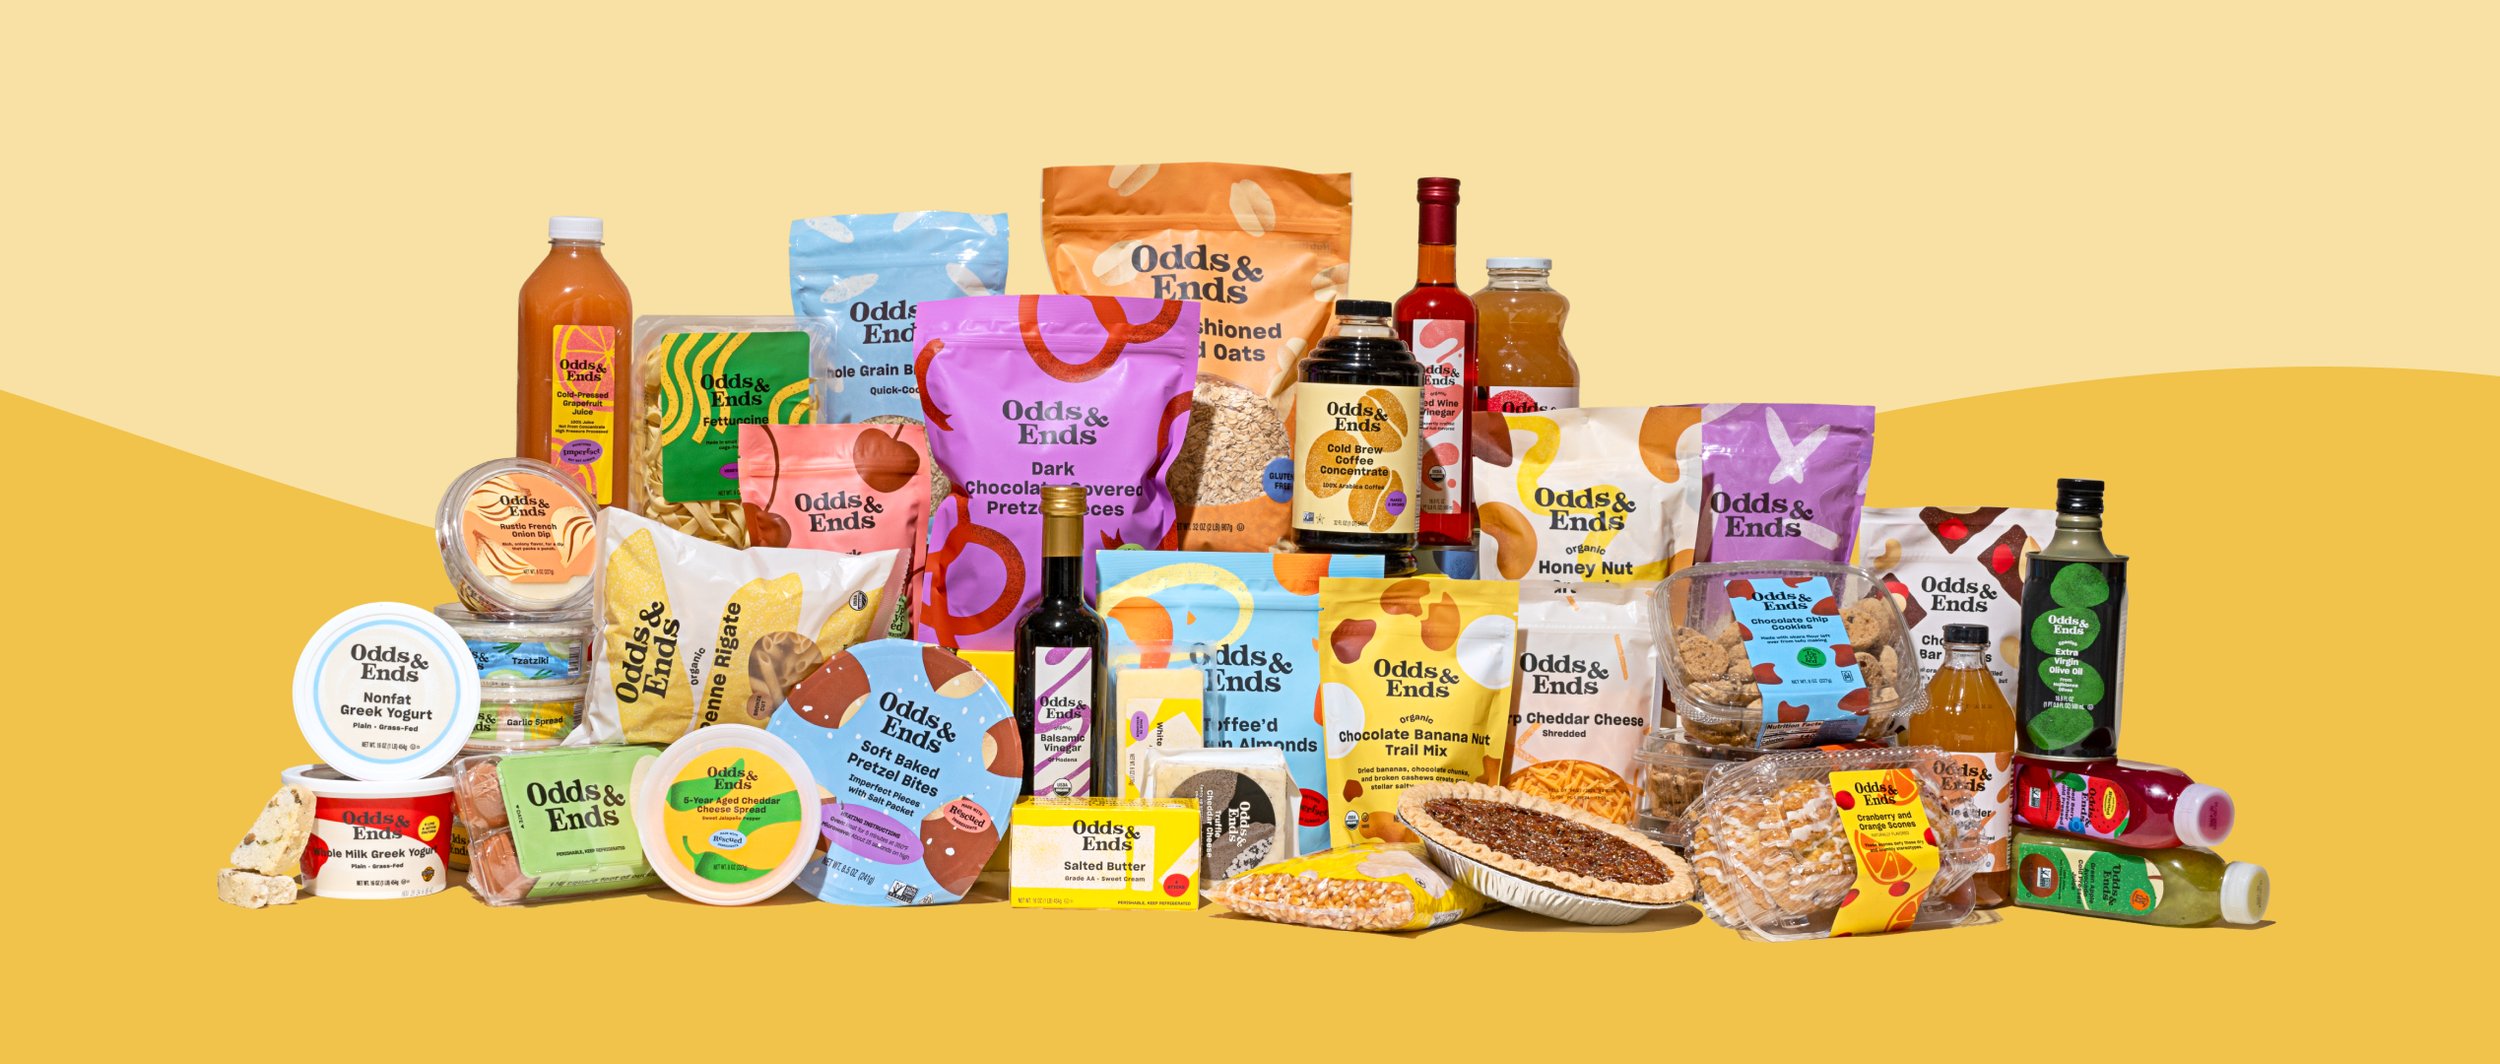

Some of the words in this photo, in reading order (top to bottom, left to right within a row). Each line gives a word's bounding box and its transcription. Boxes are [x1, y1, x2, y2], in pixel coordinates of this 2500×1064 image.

[1151, 273, 1248, 304] Ends
[850, 300, 917, 322] Odds
[863, 322, 917, 344] End
[1214, 344, 1265, 362] Oats
[567, 370, 602, 382] Ends
[860, 364, 899, 376] Grain
[1424, 375, 1456, 386] Ends
[563, 400, 602, 408] Grapefruit
[711, 391, 762, 408] Ends
[1437, 399, 1459, 408] Wine
[572, 408, 594, 416] Juice
[703, 416, 769, 427] Fettuccine
[1334, 416, 1381, 432] Ends
[1018, 422, 1098, 446] Ends
[563, 448, 600, 456] Imperfect
[1328, 444, 1351, 453] Cold
[1355, 445, 1384, 454] Brew
[1336, 456, 1374, 464] Coffee
[1032, 462, 1075, 476] Dark
[1320, 466, 1388, 476] Concentrate
[510, 506, 546, 517] Ends
[808, 512, 876, 532] Ends
[1549, 509, 1625, 532] Ends
[1724, 516, 1802, 538] Ends
[512, 530, 536, 538] Onion
[538, 531, 551, 540] Dip
[1566, 544, 1606, 556] Organic
[1538, 560, 1596, 578] Honey
[1602, 561, 1633, 575] Nut
[1762, 601, 1808, 611] Ends
[1930, 594, 1988, 612] Ends
[1806, 616, 1828, 624] Chip
[716, 602, 742, 668] Rigate
[2053, 624, 2084, 635] Ends
[642, 618, 680, 699] Ends
[1920, 649, 1942, 660] Bar
[2056, 648, 2078, 656] Extra
[512, 656, 549, 664] Tzatziki
[2054, 657, 2078, 666] Virgin
[360, 662, 420, 682] Ends
[2049, 666, 2070, 674] Olive
[1204, 668, 1282, 692] Ends
[1532, 674, 1599, 695] Ends
[1386, 679, 1450, 698] Ends
[363, 692, 412, 705] Nonfat
[340, 704, 382, 718] Greek
[386, 708, 432, 722] Yogurt
[1046, 708, 1082, 719] Ends
[1400, 714, 1434, 724] Organic
[1526, 712, 1590, 725] Cheddar
[1594, 714, 1644, 726] Cheese
[352, 722, 372, 730] Plain
[378, 724, 418, 732] Grass-Fed
[506, 718, 532, 726] Garlic
[535, 716, 564, 726] Spread
[880, 714, 942, 754] Ends
[1040, 733, 1085, 742] Balsamic
[1156, 722, 1164, 746] White
[1339, 728, 1410, 743] Chocolate
[1414, 728, 1468, 743] Banana
[1472, 732, 1490, 746] Nut
[1542, 730, 1586, 738] Shredded
[1044, 743, 1082, 754] Vinegar
[1240, 738, 1318, 752] Almonds
[1386, 744, 1418, 756] Trail
[1424, 745, 1448, 757] Mix
[861, 740, 892, 760] Soft
[894, 752, 940, 780] Baked
[847, 752, 900, 783] Pretzel
[903, 774, 938, 798] Bites
[1358, 766, 1374, 774] Dried
[1376, 766, 1410, 774] bananas,
[1412, 766, 1446, 774] chocolate
[714, 778, 752, 790] Ends
[1362, 774, 1372, 782] and
[1374, 774, 1399, 782] broken
[1401, 774, 1434, 782] cashews
[1436, 774, 1454, 782] create
[848, 774, 891, 796] Imperfect
[892, 790, 920, 809] Pieces
[716, 797, 739, 807] Aged
[742, 797, 780, 805] Cheddar
[848, 785, 866, 800] with
[867, 792, 884, 806] Salt
[884, 799, 914, 818] Packet
[1864, 794, 1896, 806] Ends
[697, 806, 732, 814] Cheese
[734, 806, 766, 814] Spread
[1206, 790, 1214, 825] Cheddar
[2080, 792, 2088, 823] Ends
[516, 809, 524, 824] DATE
[545, 804, 620, 832] Ends
[948, 804, 986, 828] Rescued
[1857, 814, 1896, 822] Cranberry
[1214, 810, 1222, 838] Truffle
[1228, 808, 1240, 842] Ends
[1860, 822, 1886, 832] Orange
[1888, 821, 1916, 830] Scones
[353, 826, 402, 840] Ends
[712, 836, 743, 844] Rescued
[1082, 836, 1132, 851] Ends
[1206, 827, 1214, 858] Cheese
[313, 848, 342, 858] Whole
[346, 850, 368, 858] Milk
[372, 848, 405, 858] Greek
[409, 846, 438, 859] Yogurt
[1064, 861, 1103, 871] Salted
[1106, 861, 1146, 872] Butter
[2102, 870, 2112, 902] Ends
